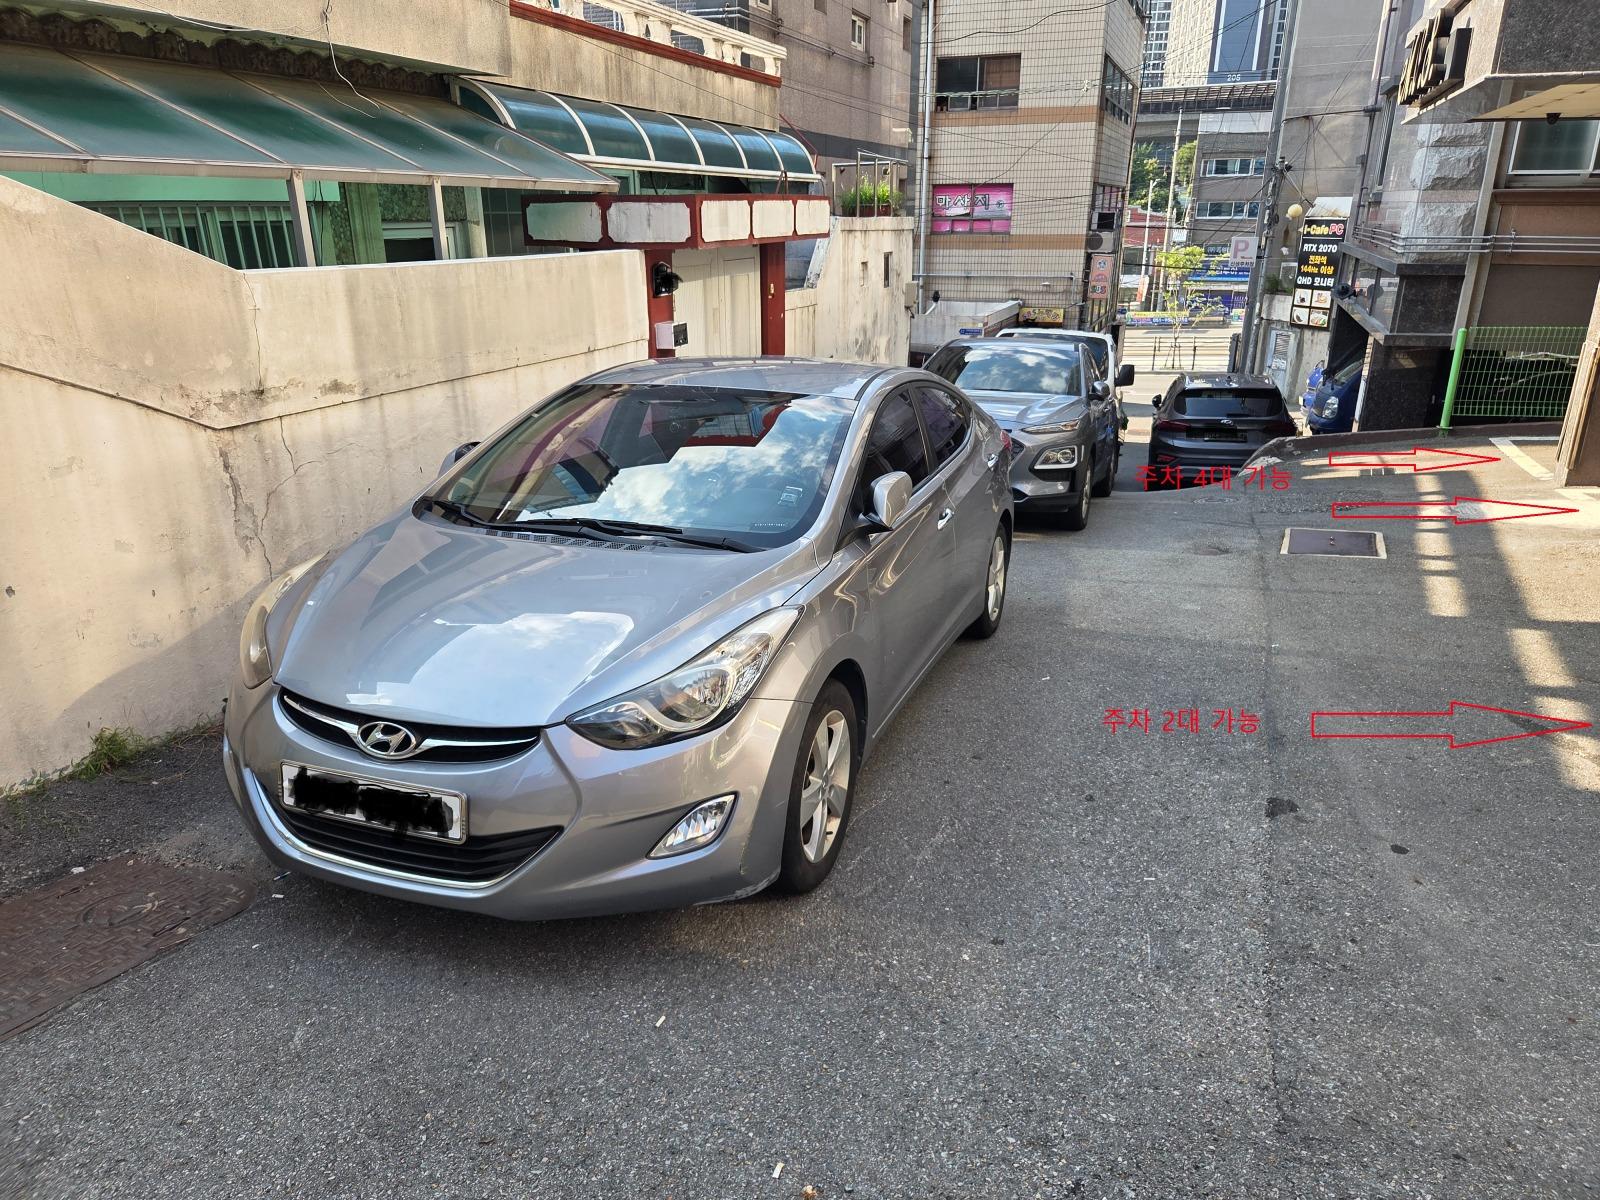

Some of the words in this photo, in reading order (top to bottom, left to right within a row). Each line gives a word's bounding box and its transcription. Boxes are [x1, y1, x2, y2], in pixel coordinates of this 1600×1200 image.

[936, 194, 990, 210] 마사지
[1233, 239, 1250, 259] P
[1303, 243, 1318, 252] RTX
[1318, 244, 1338, 253] 2070
[1308, 255, 1327, 265] 전좌석
[1320, 265, 1334, 275] 이상
[1296, 275, 1312, 285] QHD
[1313, 276, 1335, 287] 모니터
